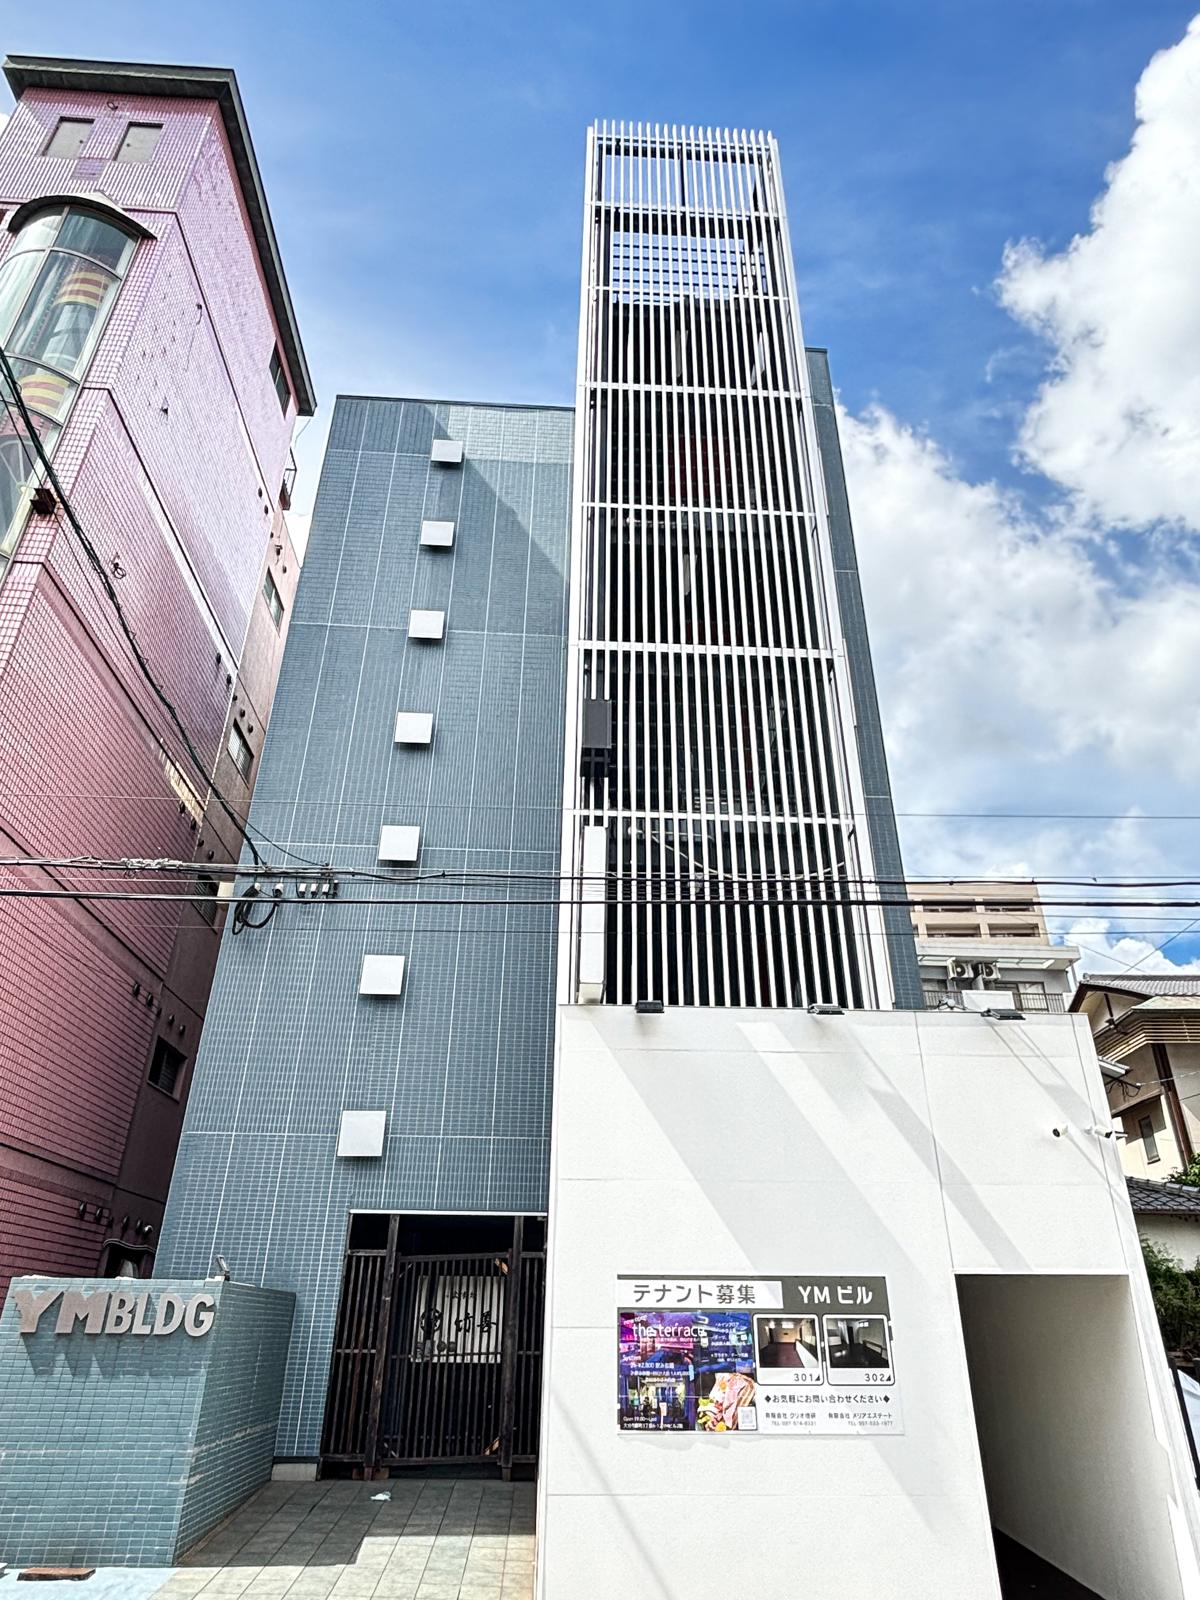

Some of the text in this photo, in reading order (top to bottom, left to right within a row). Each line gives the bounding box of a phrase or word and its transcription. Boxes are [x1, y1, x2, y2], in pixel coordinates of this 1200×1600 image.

[633, 1283, 756, 1305] テナント募集
[798, 1284, 873, 1305] YM ビル
[632, 1323, 653, 1337] the
[657, 1323, 706, 1337] terrace
[794, 1373, 814, 1382] 301
[865, 1373, 885, 1382] 302
